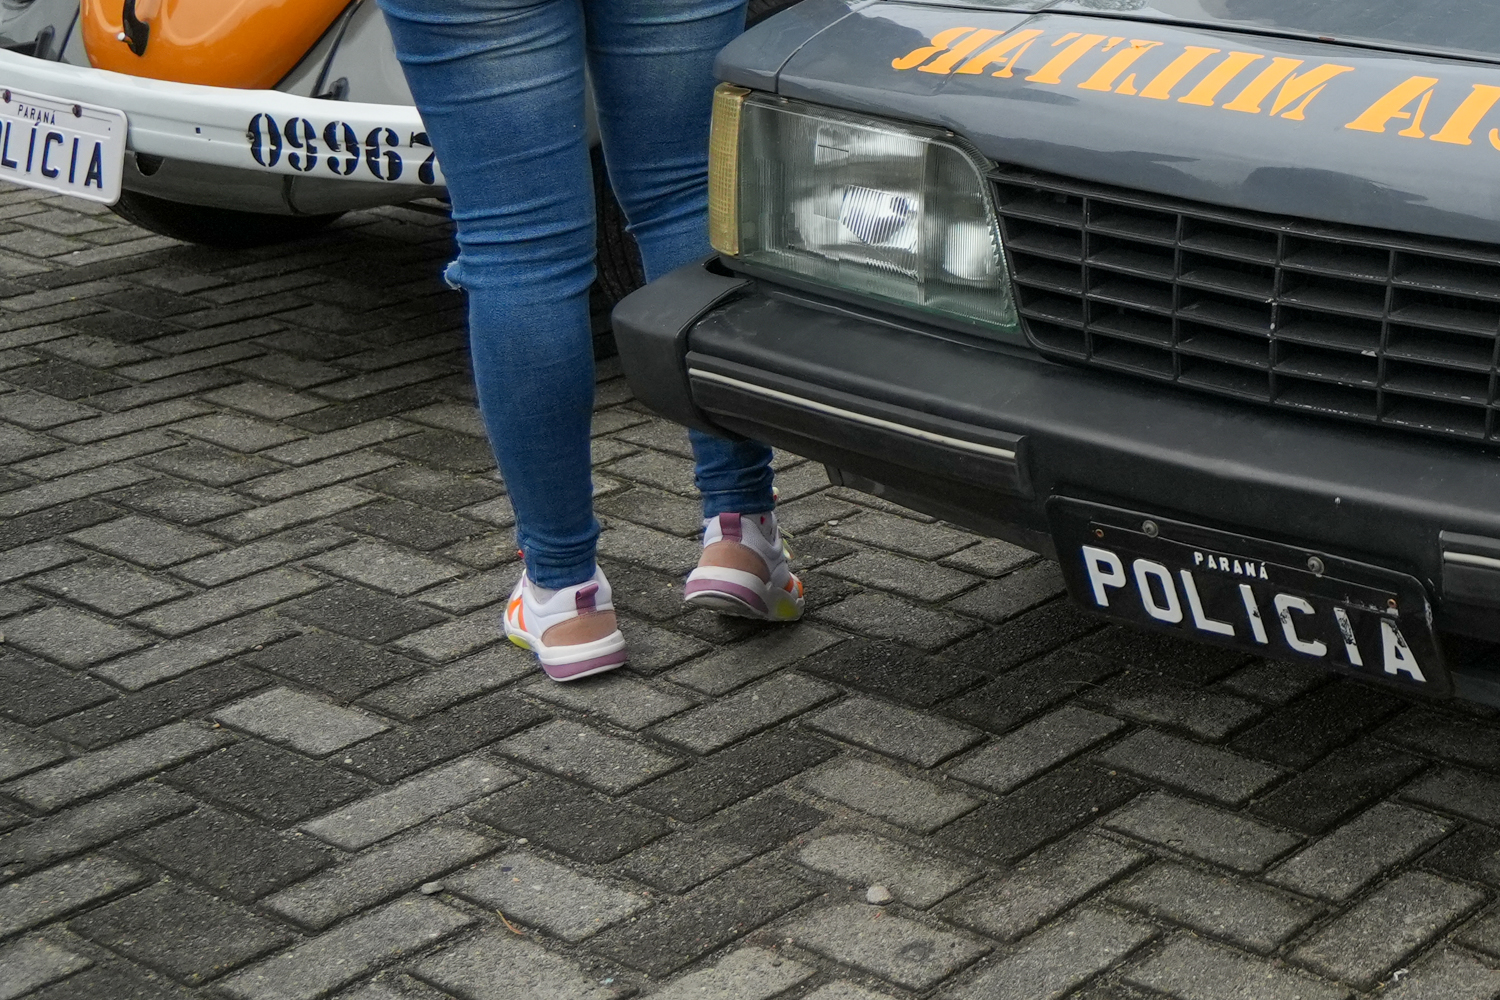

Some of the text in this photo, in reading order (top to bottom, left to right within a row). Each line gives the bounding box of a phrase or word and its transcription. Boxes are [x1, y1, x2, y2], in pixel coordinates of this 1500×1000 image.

[18, 104, 55, 126] PARANÁ
[246, 112, 436, 186] 09967
[0, 120, 103, 189] LÍCIA
[1193, 550, 1270, 581] PARANÁ
[1081, 544, 1428, 683] POLICIA
